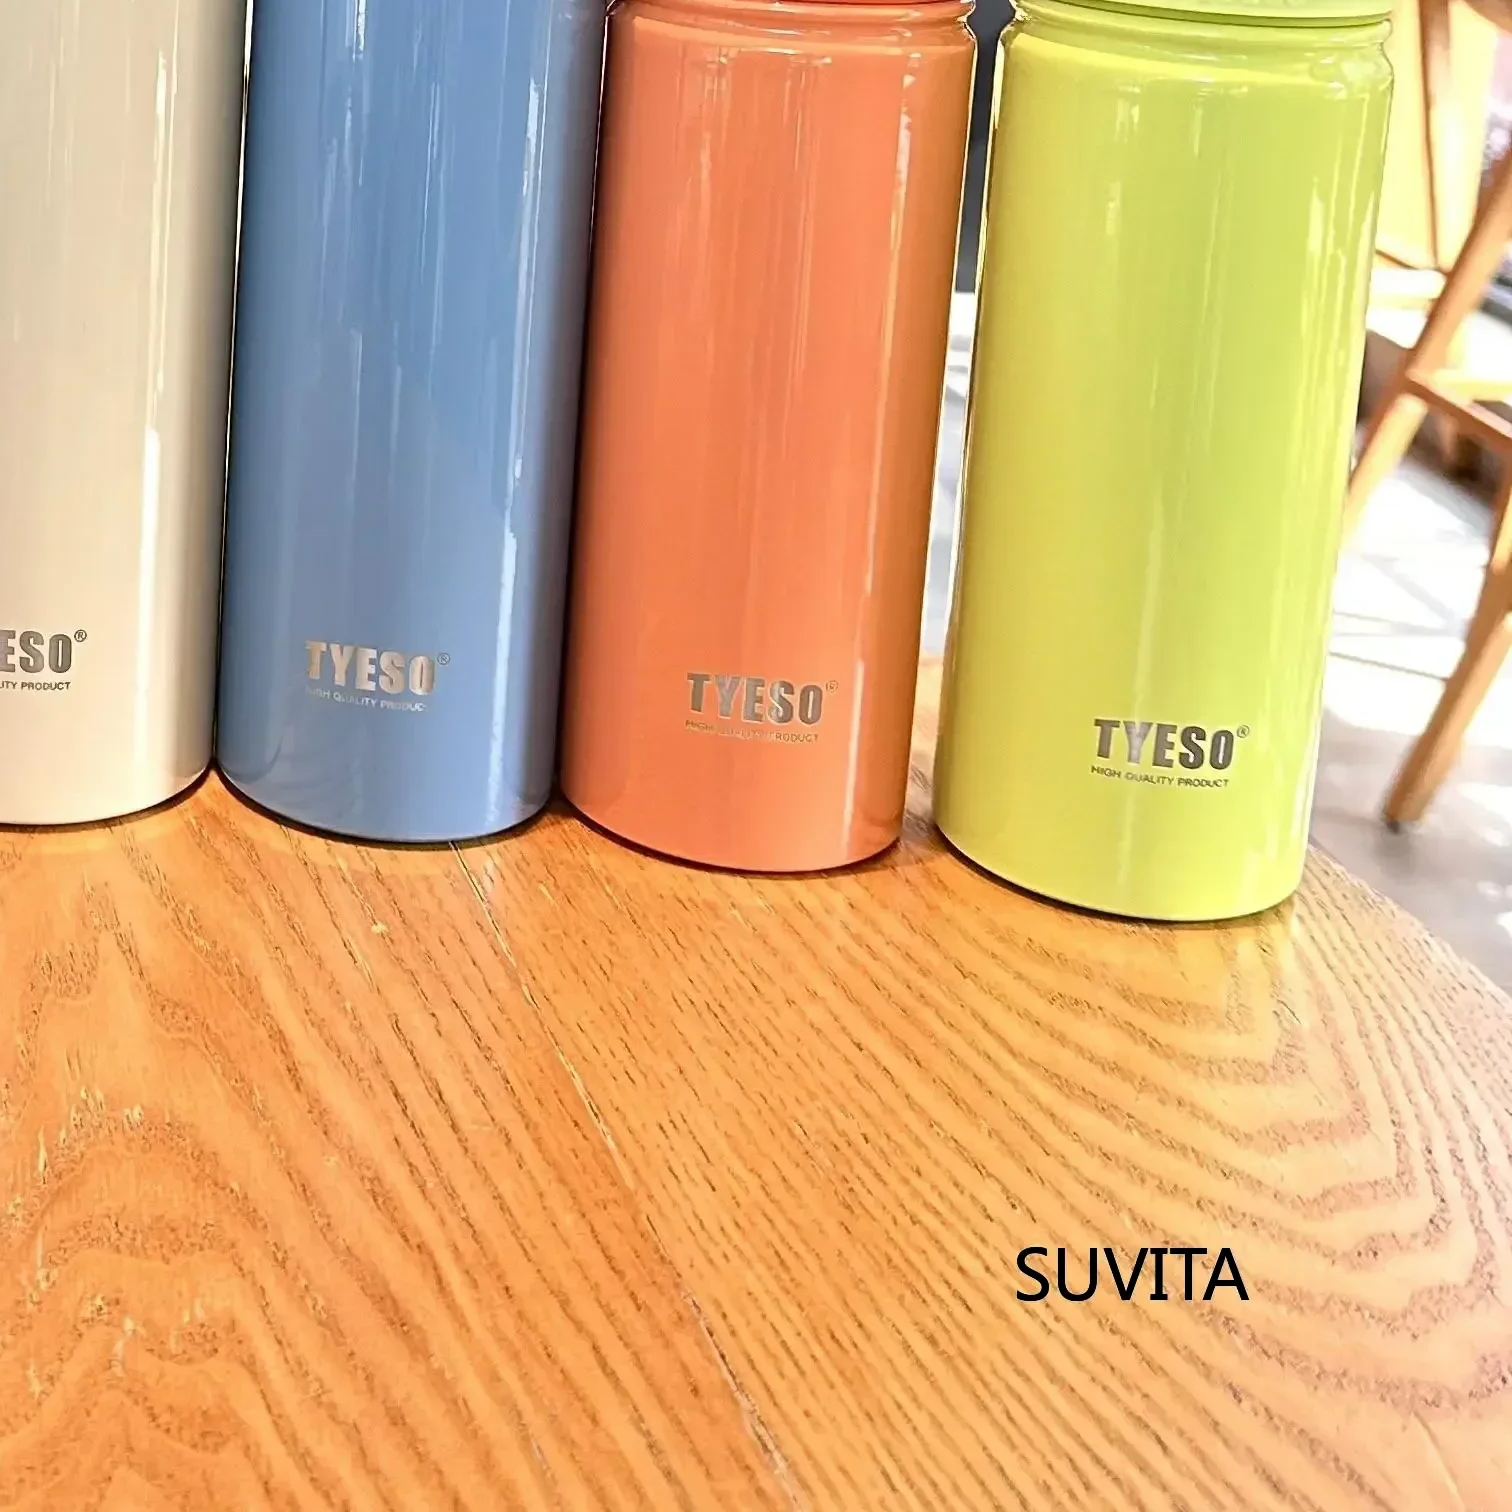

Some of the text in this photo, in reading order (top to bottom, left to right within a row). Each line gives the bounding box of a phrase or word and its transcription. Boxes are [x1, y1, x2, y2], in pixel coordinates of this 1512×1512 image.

[21, 682, 71, 691] PRODUCT
[1091, 765, 1229, 788] HIGH QUALITY PRODUCT
